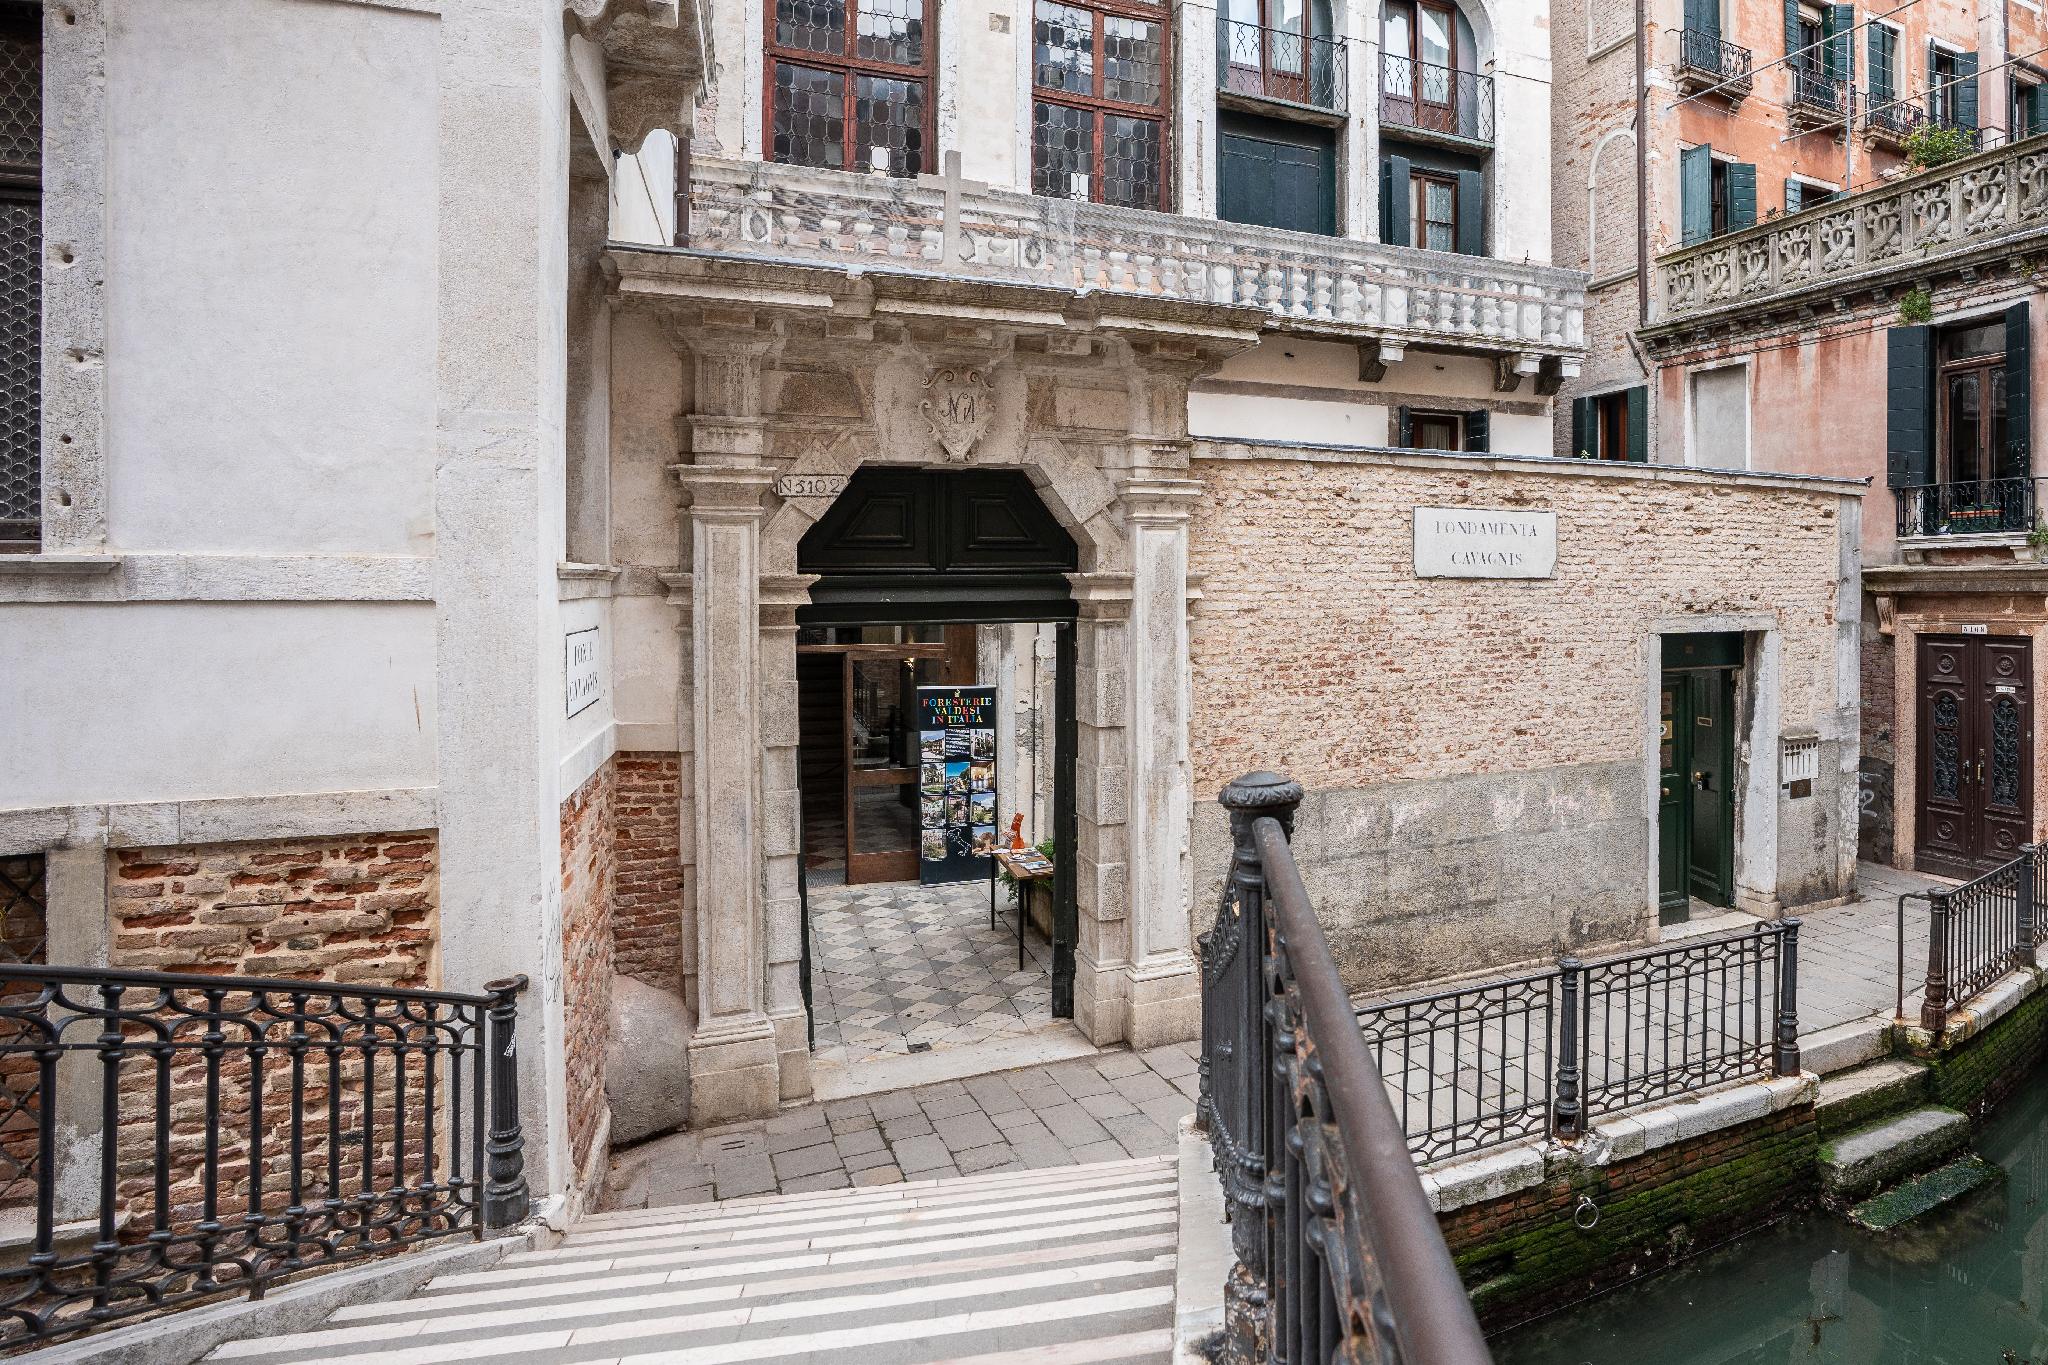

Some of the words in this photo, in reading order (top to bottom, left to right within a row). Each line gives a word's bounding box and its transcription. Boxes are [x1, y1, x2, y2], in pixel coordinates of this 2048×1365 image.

[1434, 520, 1538, 537] FONDAMENTA
[1451, 551, 1523, 566] CAVAGNIS
[922, 697, 992, 707] FORESTERIE
[934, 706, 981, 715] VALDESI
[931, 715, 944, 725] IN
[947, 714, 984, 724] ITALIA
